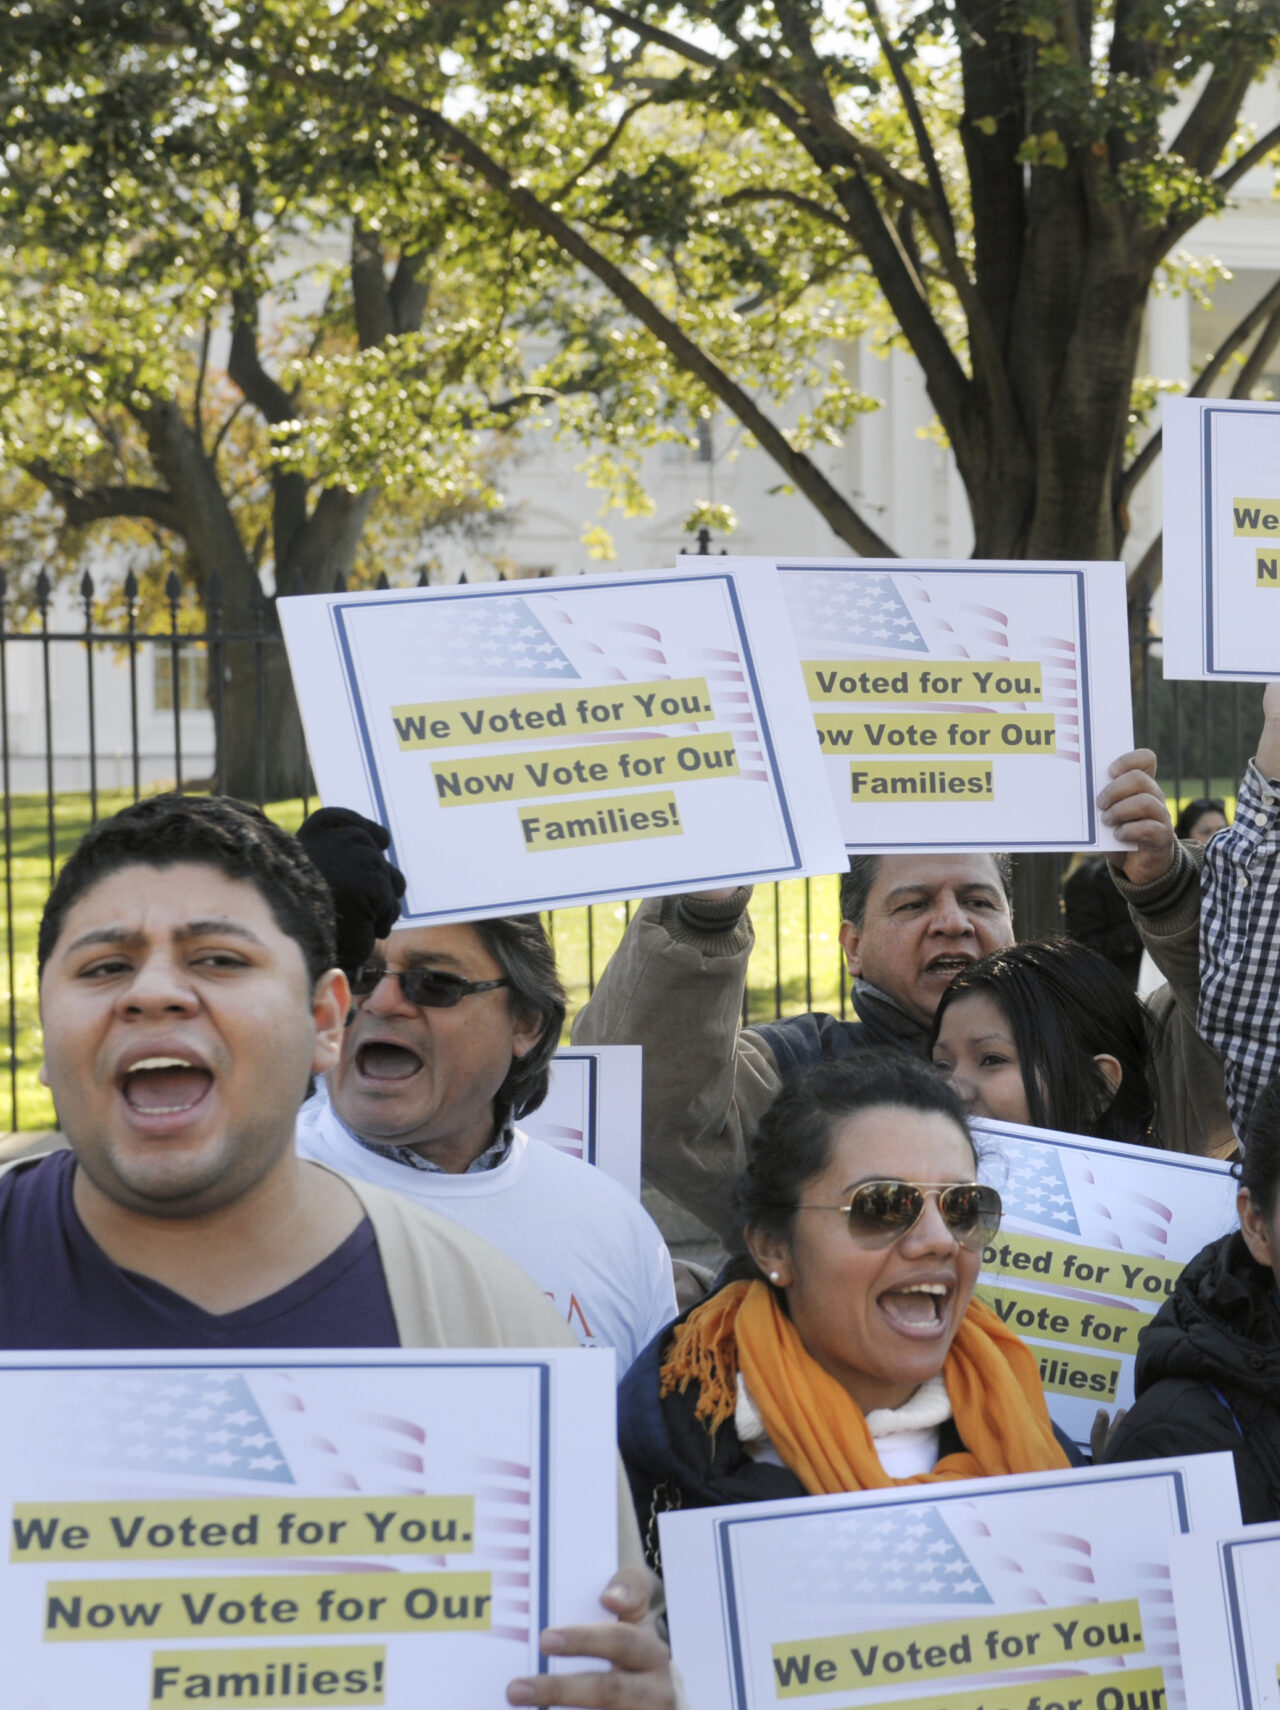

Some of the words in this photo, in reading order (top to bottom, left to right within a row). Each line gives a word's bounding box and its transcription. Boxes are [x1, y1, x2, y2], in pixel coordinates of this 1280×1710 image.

[1234, 508, 1278, 529] We
[816, 672, 908, 693] Voted
[919, 672, 962, 693] for
[973, 672, 1040, 693] You.
[394, 716, 449, 741] We
[460, 703, 566, 734] Voted
[577, 700, 623, 723] for
[634, 694, 711, 717] You.
[864, 724, 937, 745] Vote
[948, 724, 990, 745] for
[1002, 724, 1055, 745] Our
[435, 773, 513, 797] Now
[525, 761, 607, 787] Vote
[619, 754, 665, 777] for
[678, 748, 735, 771] Our
[852, 772, 992, 793] Families!
[522, 803, 679, 843] Families!
[982, 1244, 1052, 1274] oted
[1064, 1255, 1109, 1283] for
[994, 1298, 1069, 1333] Vote
[1081, 1315, 1127, 1342] for
[1040, 1359, 1118, 1394] ilies!
[14, 1519, 89, 1549] We
[111, 1515, 258, 1547] Voted
[278, 1514, 346, 1544] for
[366, 1513, 471, 1542] You.
[48, 1597, 161, 1628] Now
[182, 1594, 298, 1624] Vote
[318, 1590, 386, 1621] for
[405, 1588, 490, 1619] Our
[774, 1655, 836, 1686] We
[851, 1635, 971, 1676] Voted
[985, 1631, 1040, 1659] for
[1054, 1621, 1141, 1650] You.
[154, 1662, 383, 1699] Families!
[1097, 1688, 1165, 1710] Our
